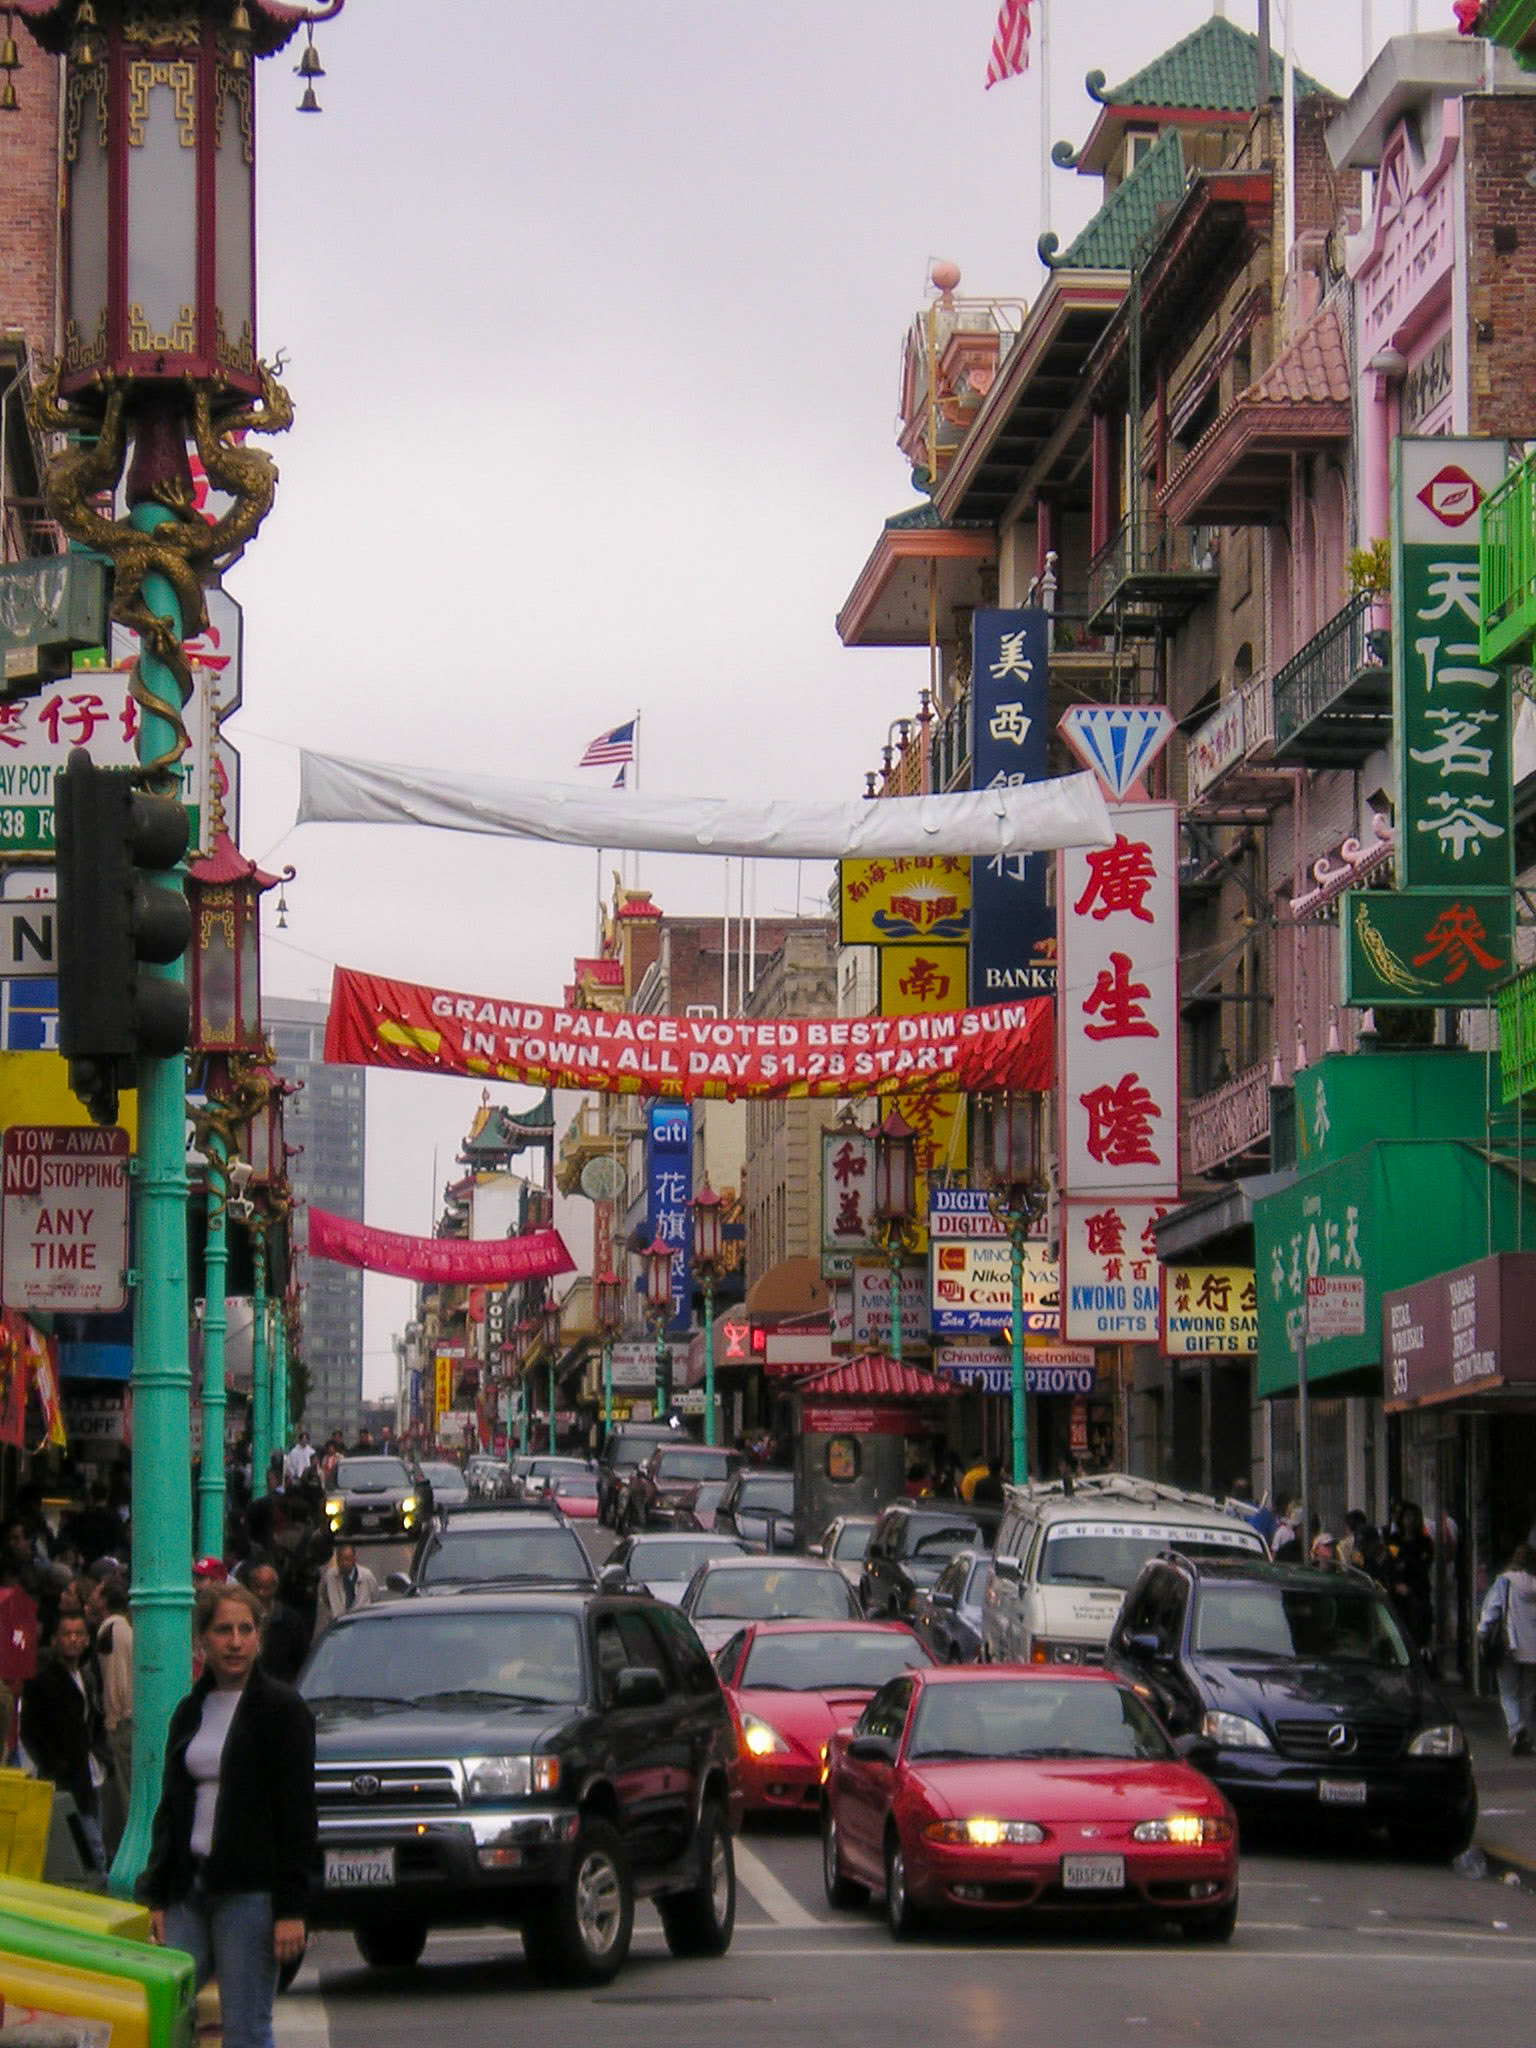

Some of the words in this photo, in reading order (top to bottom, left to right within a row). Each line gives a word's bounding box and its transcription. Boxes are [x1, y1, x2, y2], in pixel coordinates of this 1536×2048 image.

[19, 766, 51, 795] POT
[986, 968, 1049, 988] BANK
[1074, 833, 1163, 1167] 廣生隆
[431, 995, 543, 1031] GRAND
[553, 1014, 799, 1047] PALACE-VOTED
[807, 1022, 889, 1045] BEST
[898, 1013, 956, 1041] DIM
[961, 1005, 1026, 1032] SUM
[461, 1028, 496, 1052] IN
[616, 1047, 678, 1073] ALL
[688, 1053, 751, 1076] DAY
[760, 1053, 845, 1078] $1.28
[855, 1045, 959, 1075] START
[15, 1131, 118, 1151] TOW-AWAY
[654, 1123, 687, 1142] citi
[7, 1154, 38, 1189] NO
[43, 1162, 125, 1189] STOPPING
[936, 1191, 1009, 1211] DIGIT
[35, 1208, 95, 1235] ANY
[31, 1243, 97, 1270] TIME
[972, 1248, 1031, 1263] MINOA
[863, 1275, 924, 1291] Caon
[972, 1270, 1011, 1283] Niko
[1308, 1278, 1326, 1294] NO
[969, 1289, 1035, 1304] Cann
[1072, 1286, 1127, 1311] KWONG
[867, 1312, 919, 1325] PENAX
[967, 1311, 1014, 1330] Francis
[1097, 1316, 1147, 1332] GIFTS
[1169, 1316, 1225, 1333] KWONG
[1186, 1336, 1239, 1352] GIFTS
[942, 1351, 1011, 1365] Chinatown
[1025, 1351, 1091, 1365] lectronics
[1025, 1369, 1092, 1392] PHOTO
